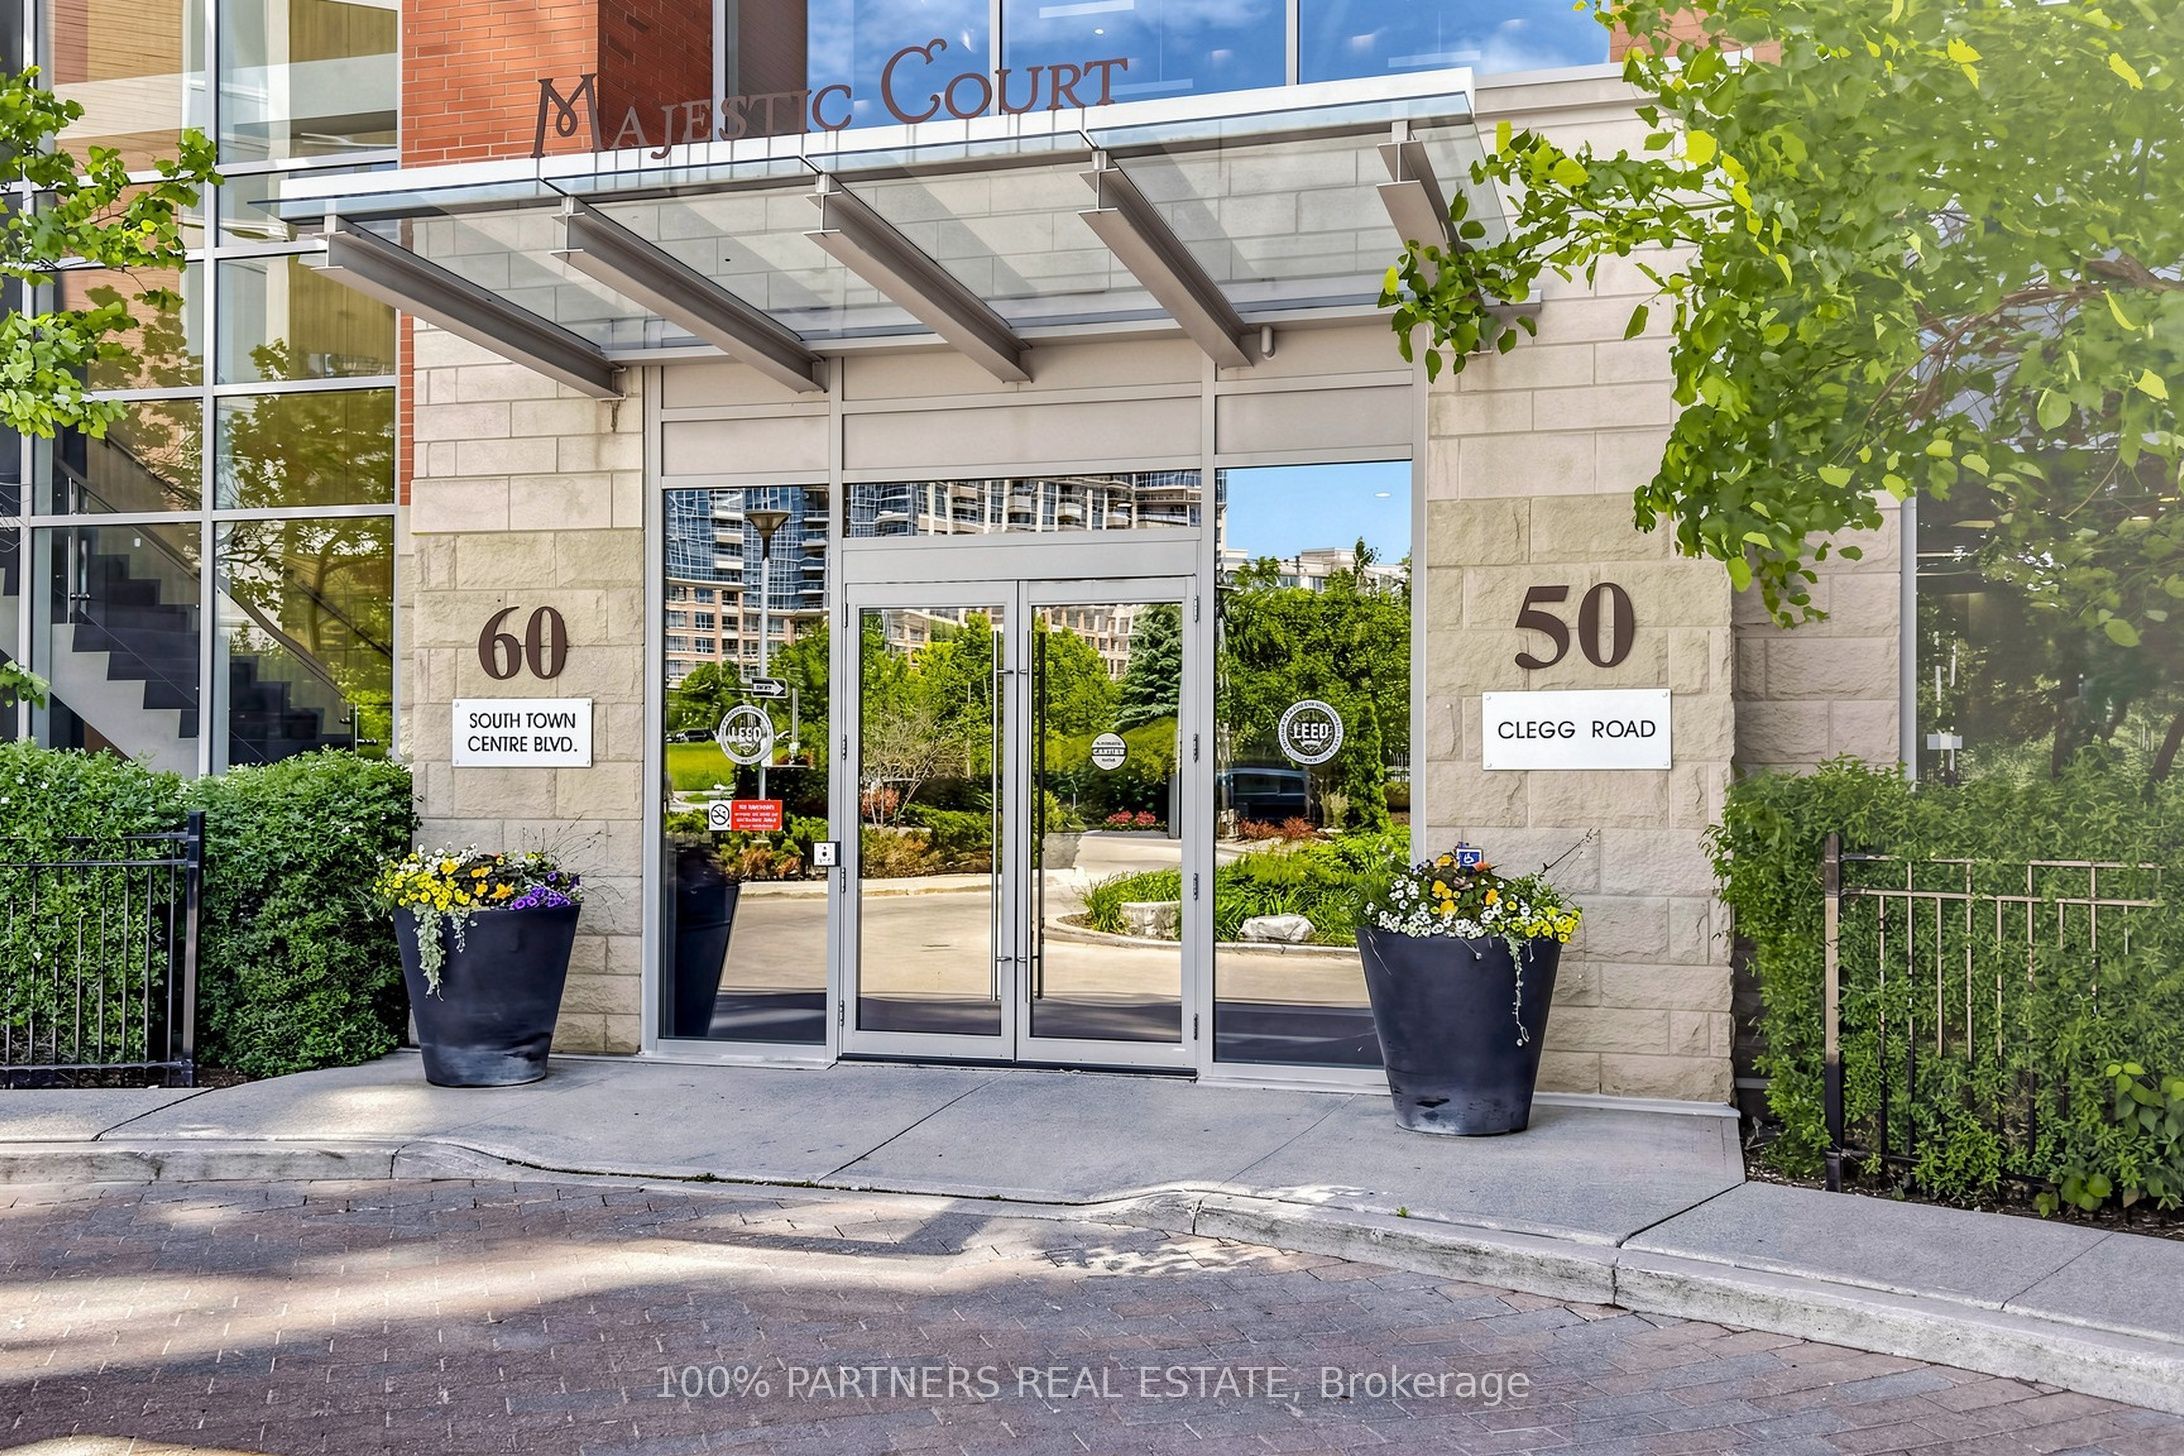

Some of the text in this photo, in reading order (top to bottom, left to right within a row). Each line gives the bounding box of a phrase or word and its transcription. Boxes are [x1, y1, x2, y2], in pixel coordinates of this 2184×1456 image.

[1514, 582, 1635, 670] 50
[478, 605, 568, 680] 60
[469, 712, 576, 729] SOUTH TOWN
[1497, 720, 1656, 739] CLEGG ROAD
[1293, 722, 1329, 739] LEED
[467, 735, 578, 752] CENTRE BLVD.
